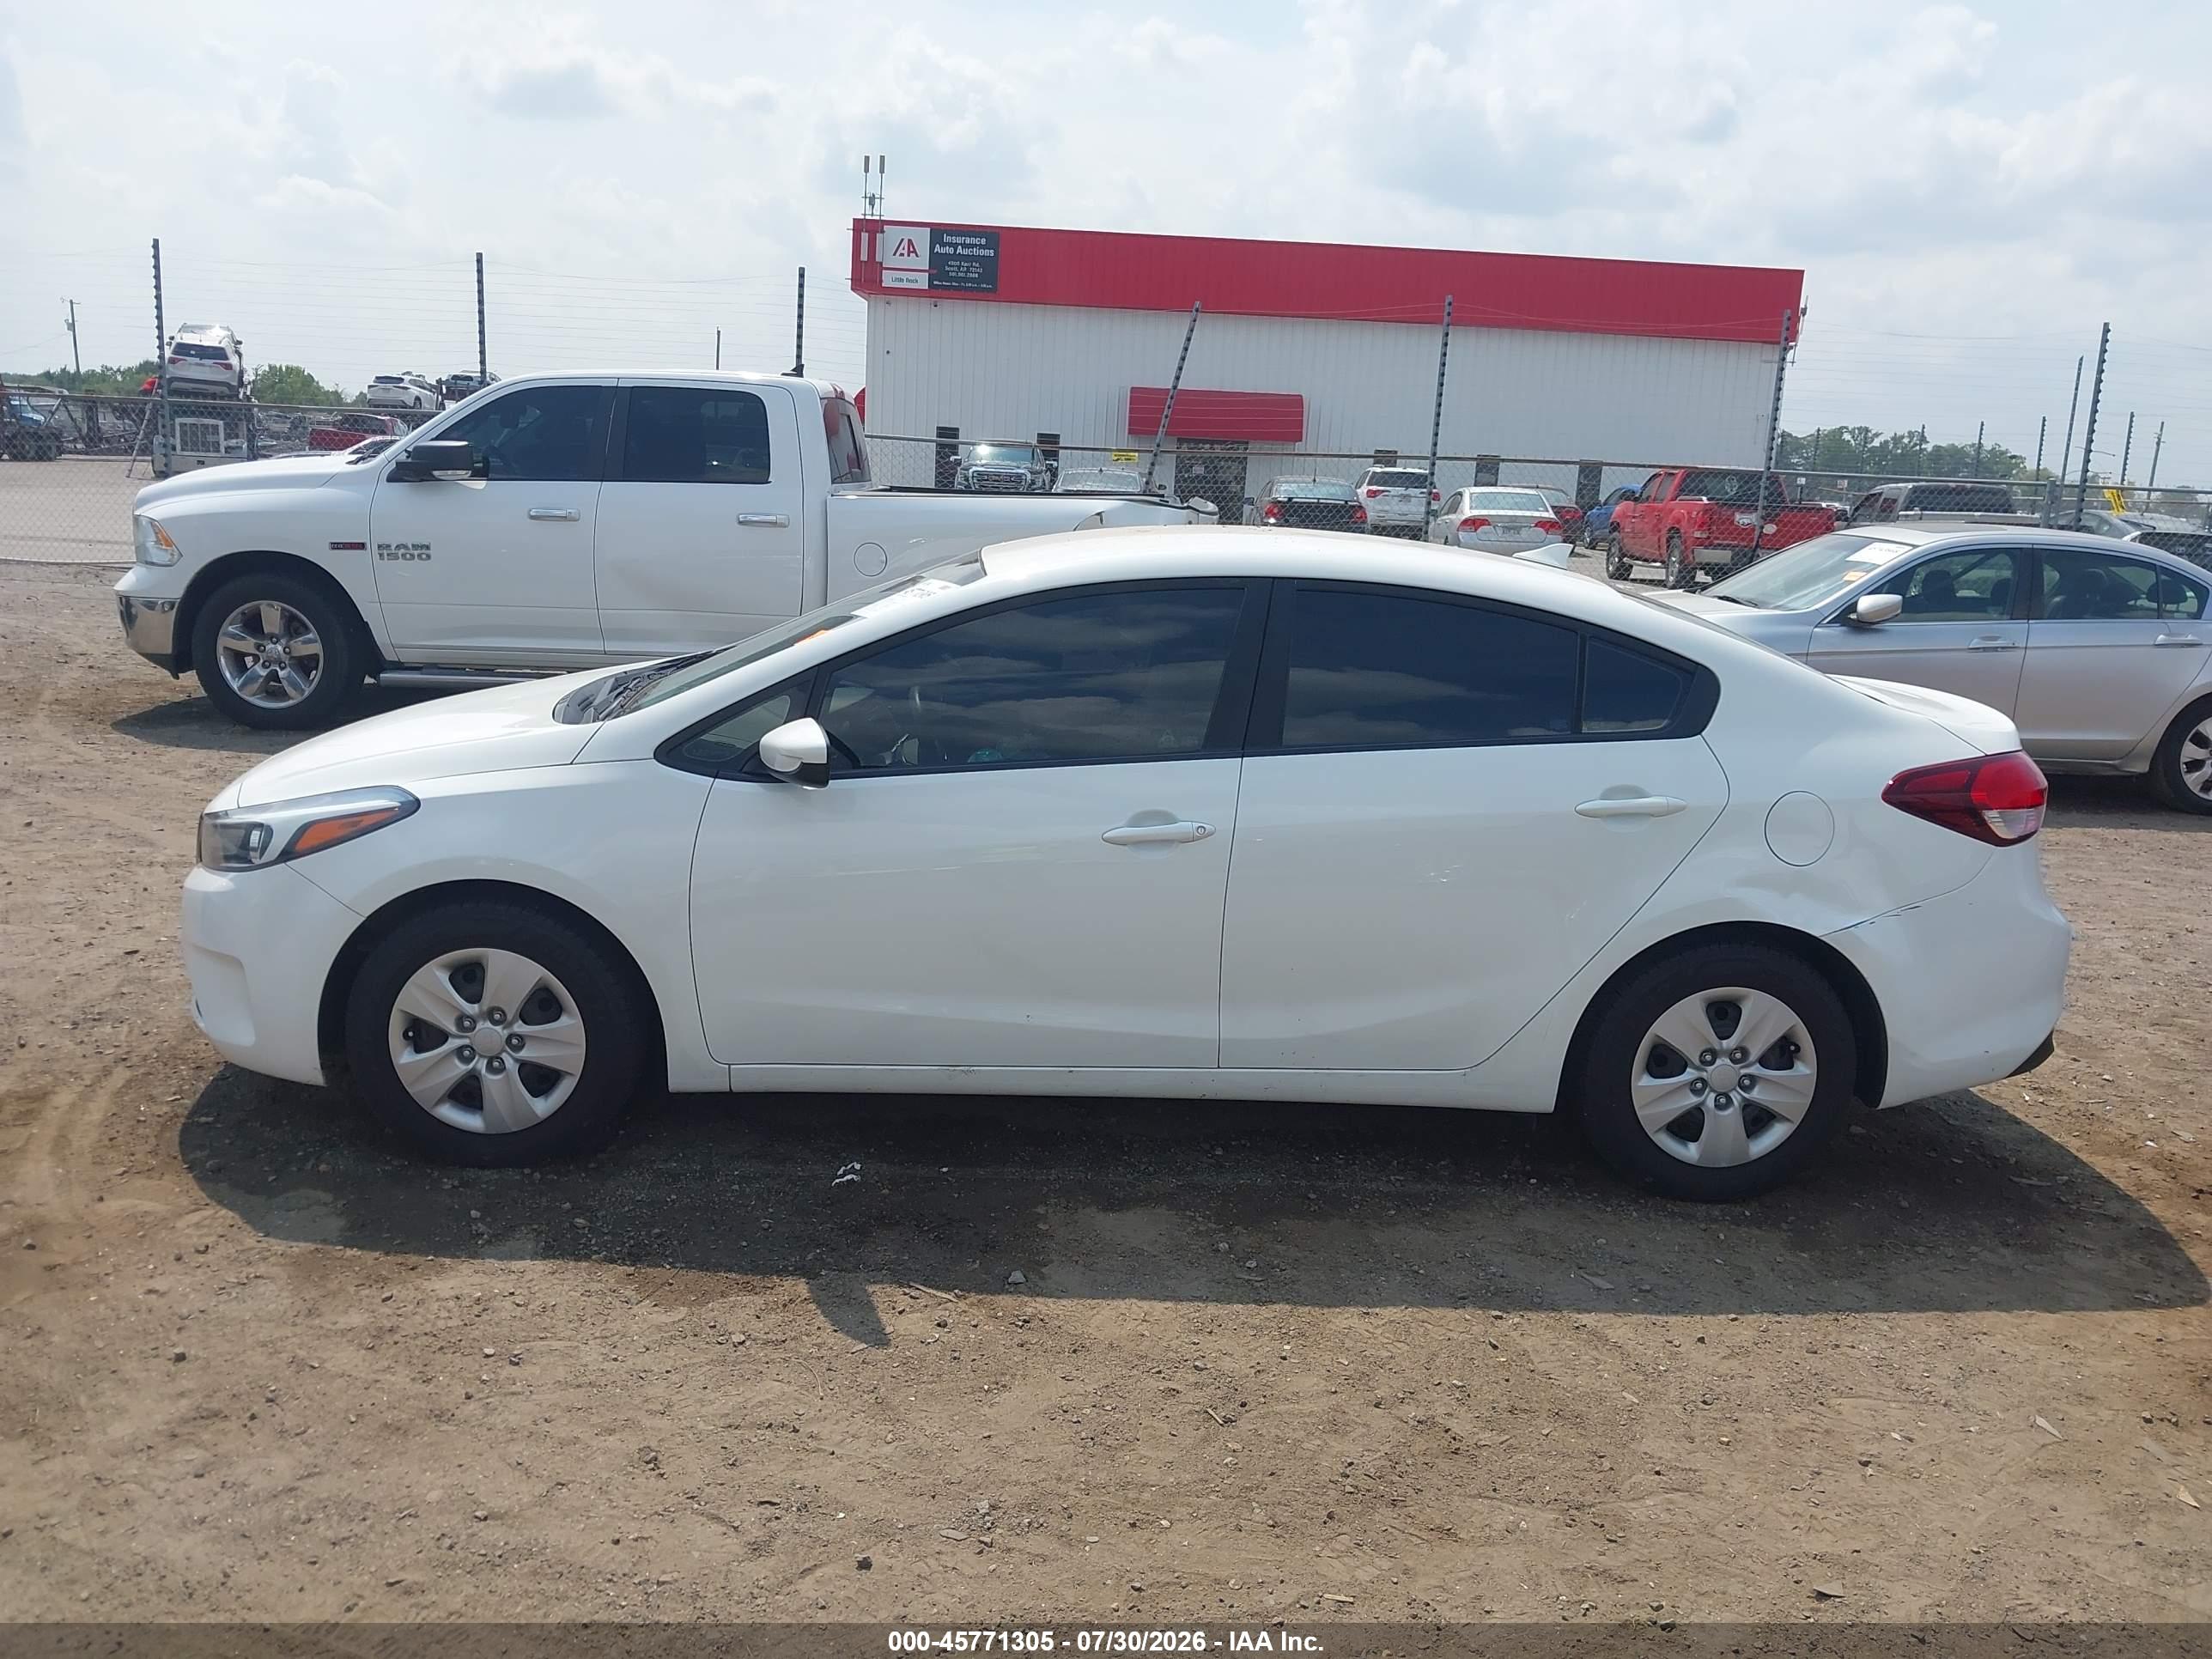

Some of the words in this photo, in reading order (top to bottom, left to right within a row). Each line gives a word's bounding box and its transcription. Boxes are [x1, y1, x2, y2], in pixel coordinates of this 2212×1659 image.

[944, 234, 986, 245] Insurance
[934, 244, 954, 253] Auto
[957, 246, 994, 256] Auctions
[378, 552, 431, 561] 1500
